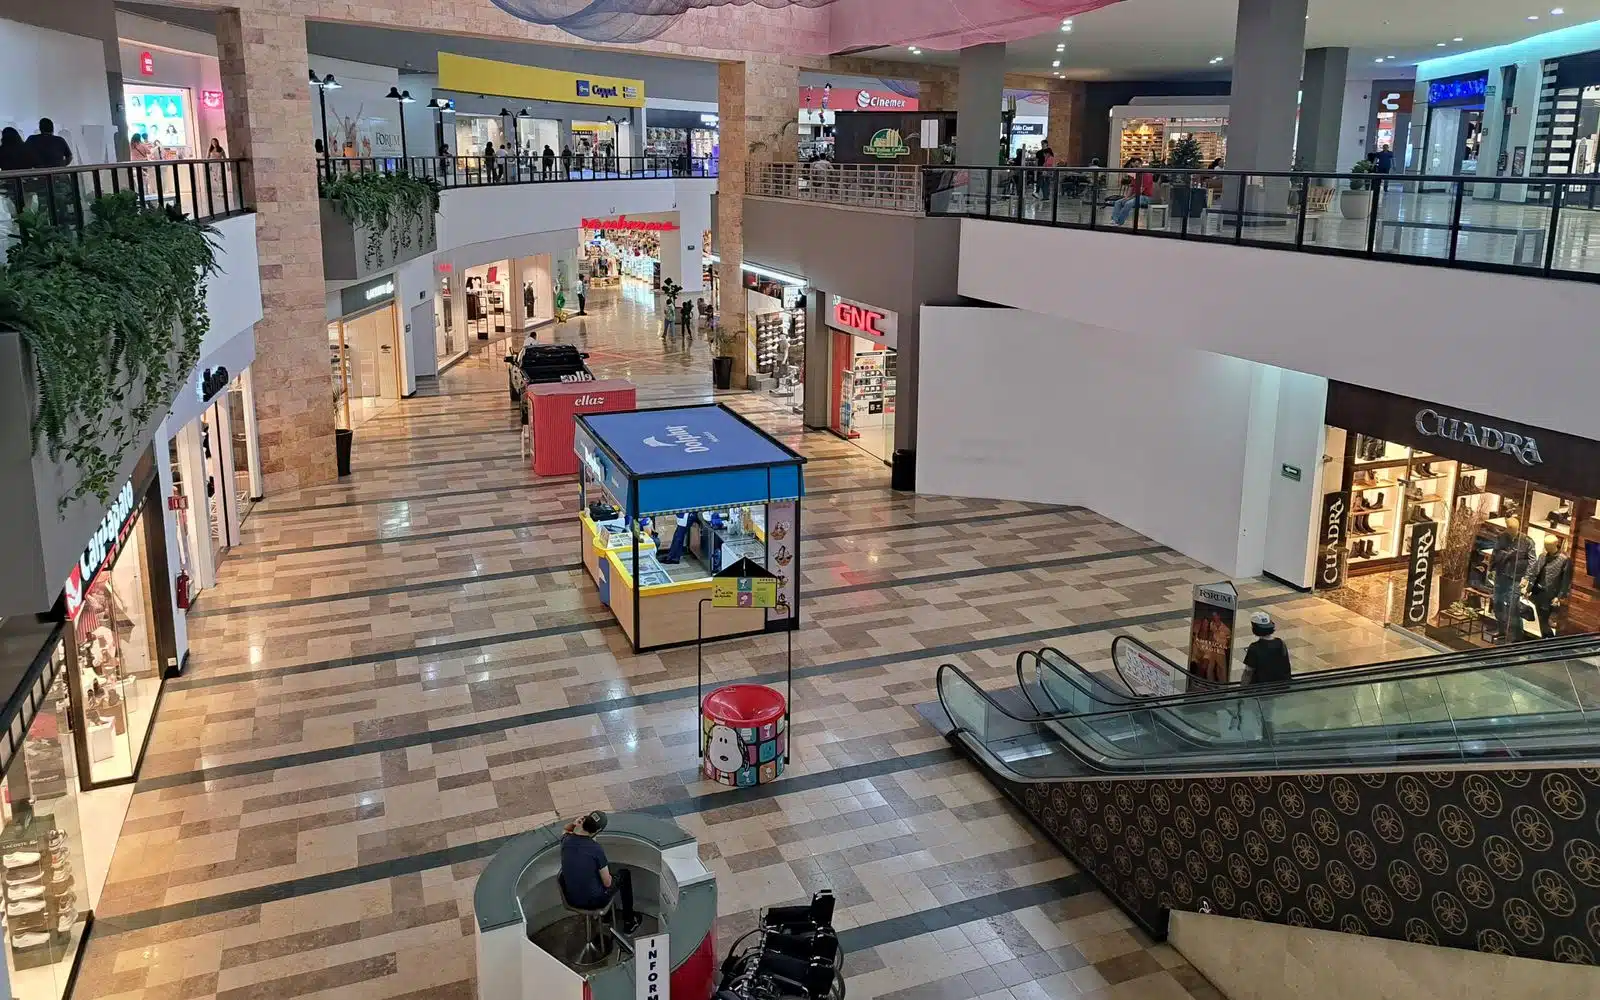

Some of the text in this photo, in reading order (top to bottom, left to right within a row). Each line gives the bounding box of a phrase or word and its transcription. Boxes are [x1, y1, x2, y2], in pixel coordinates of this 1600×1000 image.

[870, 96, 906, 107] Cinemex
[376, 132, 401, 148] FORUM
[836, 302, 885, 337] GNC
[574, 395, 604, 407] ellaz
[665, 425, 710, 453] Dolphy
[1415, 408, 1543, 466] CUADRA
[1323, 497, 1345, 584] CUADRA
[1409, 528, 1434, 622] CUADRA
[1199, 589, 1231, 603] FORUM
